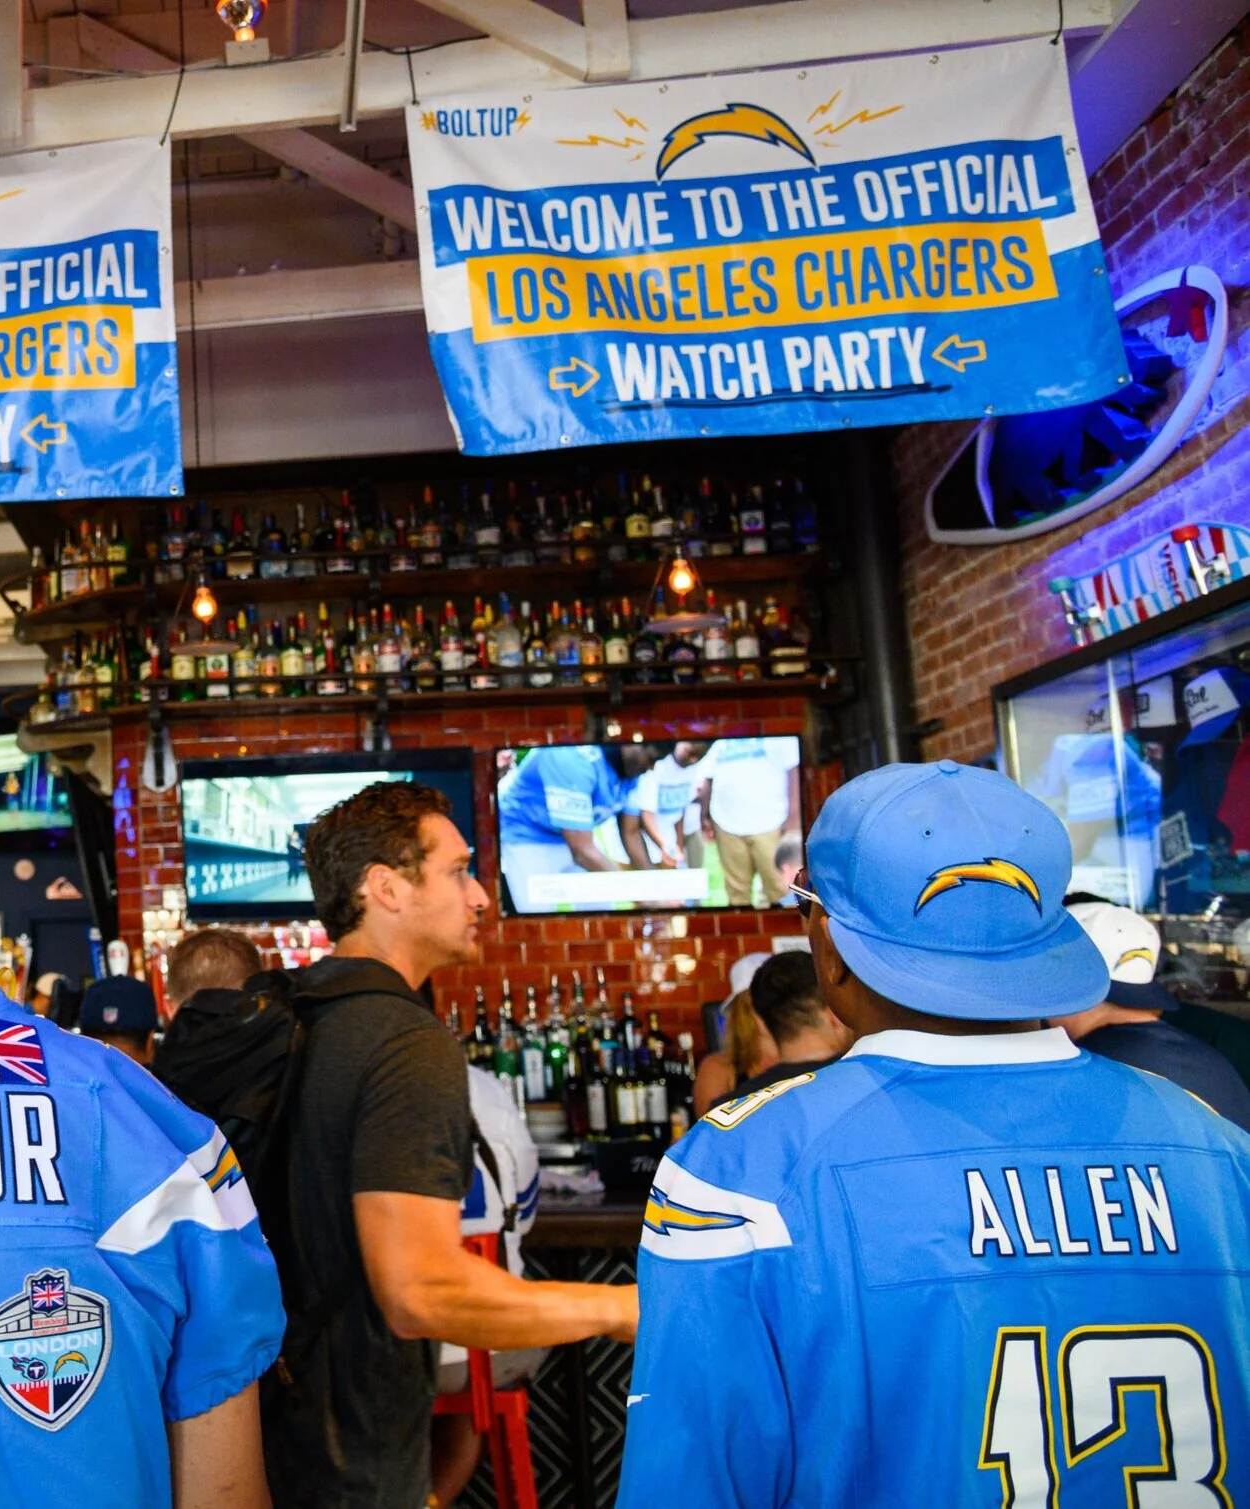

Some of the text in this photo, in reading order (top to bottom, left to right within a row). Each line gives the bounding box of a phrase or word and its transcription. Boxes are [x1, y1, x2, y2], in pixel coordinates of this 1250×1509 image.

[444, 153, 1057, 255] WELCOME TO THE OFFICIAL
[485, 235, 1034, 325] LOS ANGELES CHARGERS
[606, 326, 930, 403] WATCH PARTY
[964, 1164, 1179, 1258] ALLEN
[977, 1323, 1237, 1509] 13
